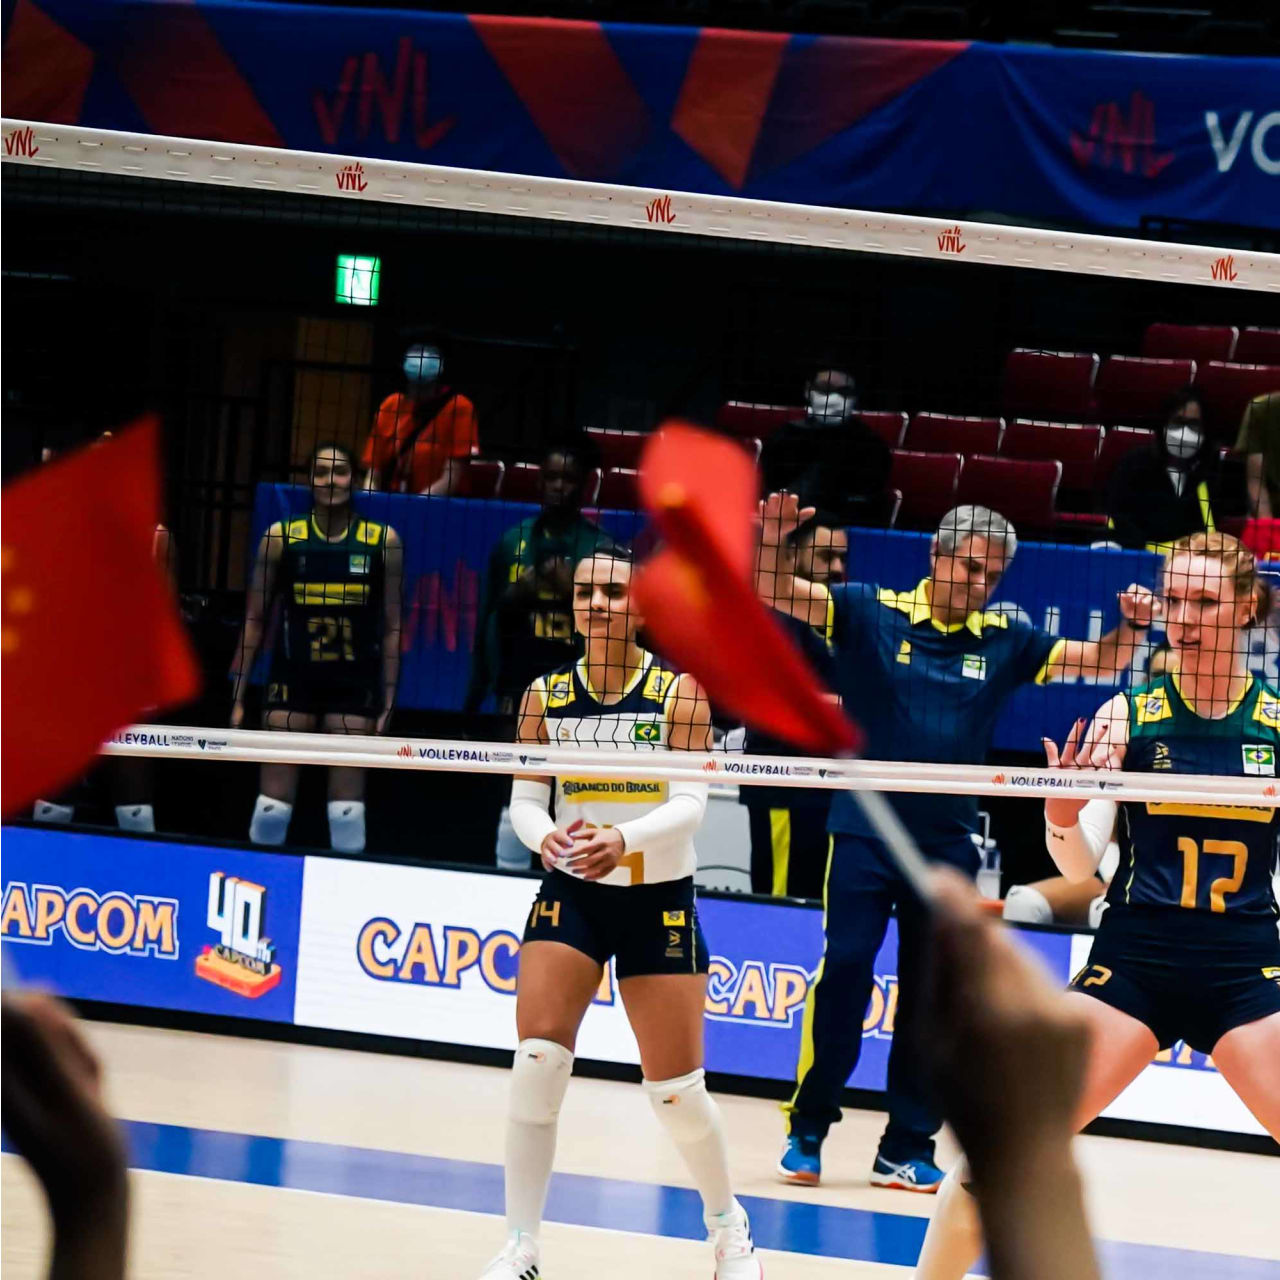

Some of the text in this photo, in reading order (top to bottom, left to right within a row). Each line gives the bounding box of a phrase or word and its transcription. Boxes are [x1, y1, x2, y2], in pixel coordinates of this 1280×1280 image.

[307, 616, 355, 662] 21
[419, 747, 490, 762] VOLLEYBALL
[724, 762, 791, 776] VOLLEYBALL
[575, 781, 661, 792] BANCO DO BRASIL
[1011, 775, 1074, 788] VOLLEYBALL
[1177, 836, 1248, 913] 17
[0, 884, 178, 958] APCOM
[531, 900, 561, 928] 14
